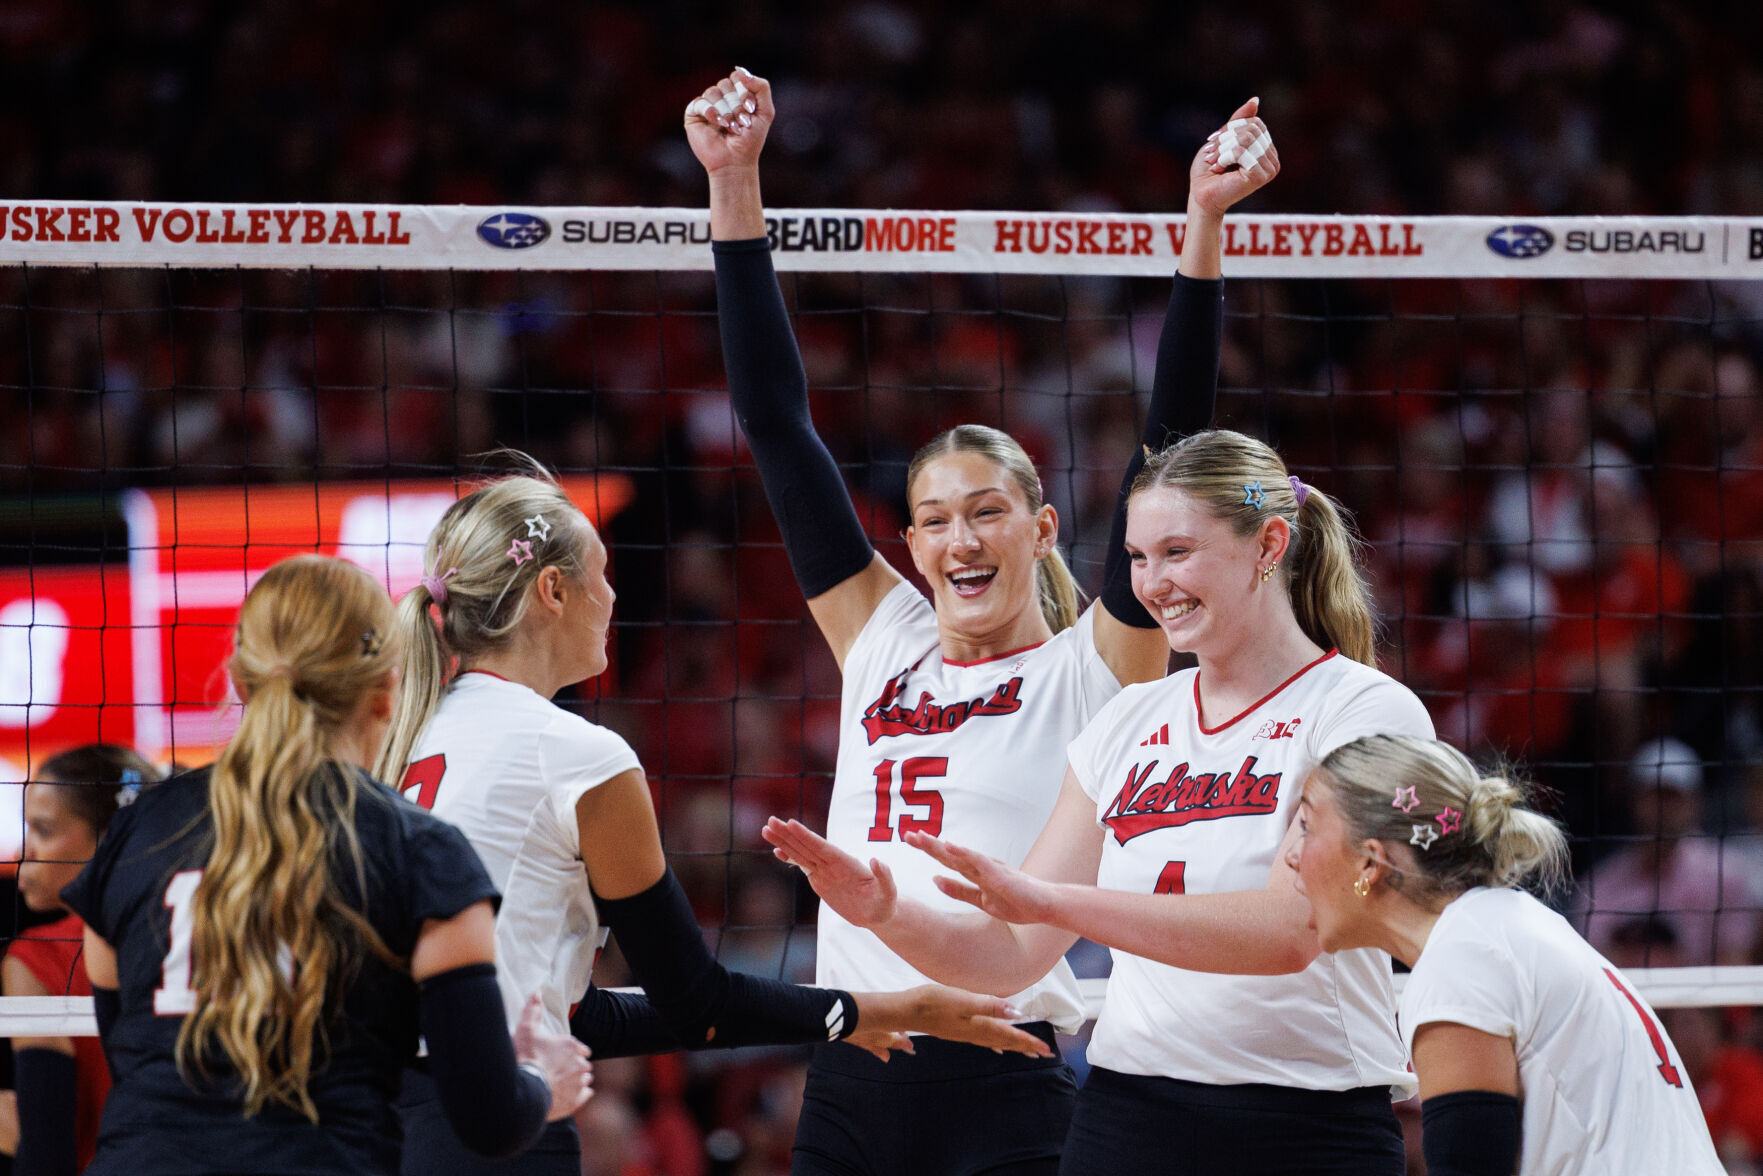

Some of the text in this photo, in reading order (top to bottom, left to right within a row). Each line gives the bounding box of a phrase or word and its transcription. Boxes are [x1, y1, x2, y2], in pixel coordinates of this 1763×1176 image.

[132, 207, 411, 245] VOLLEYBALL
[562, 220, 711, 244] SUBARU
[994, 220, 1424, 257] HUSKER VLLEYBALL
[1564, 230, 1705, 252] SUBARU
[867, 756, 949, 843] 15
[1101, 755, 1283, 847] Nebraska
